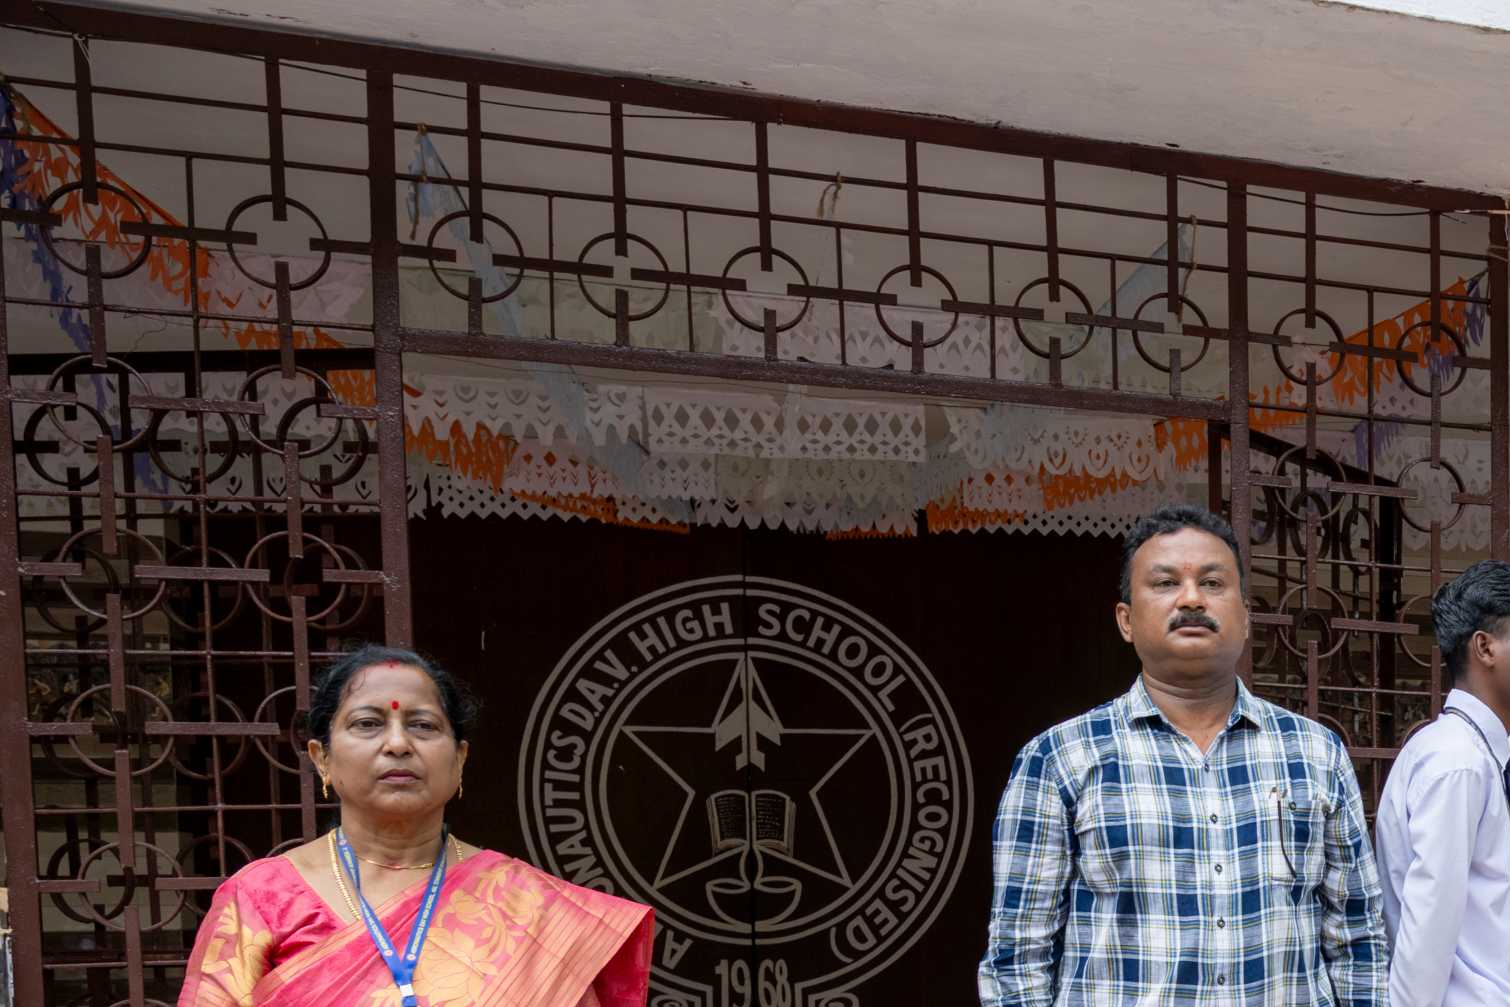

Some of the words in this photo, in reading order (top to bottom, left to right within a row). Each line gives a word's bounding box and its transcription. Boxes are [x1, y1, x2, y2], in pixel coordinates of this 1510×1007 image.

[628, 602, 734, 662] HIGH
[757, 603, 906, 712] SCHOOL
[559, 649, 638, 732] D.A.V.
[829, 713, 951, 962] (RECOGNISED)
